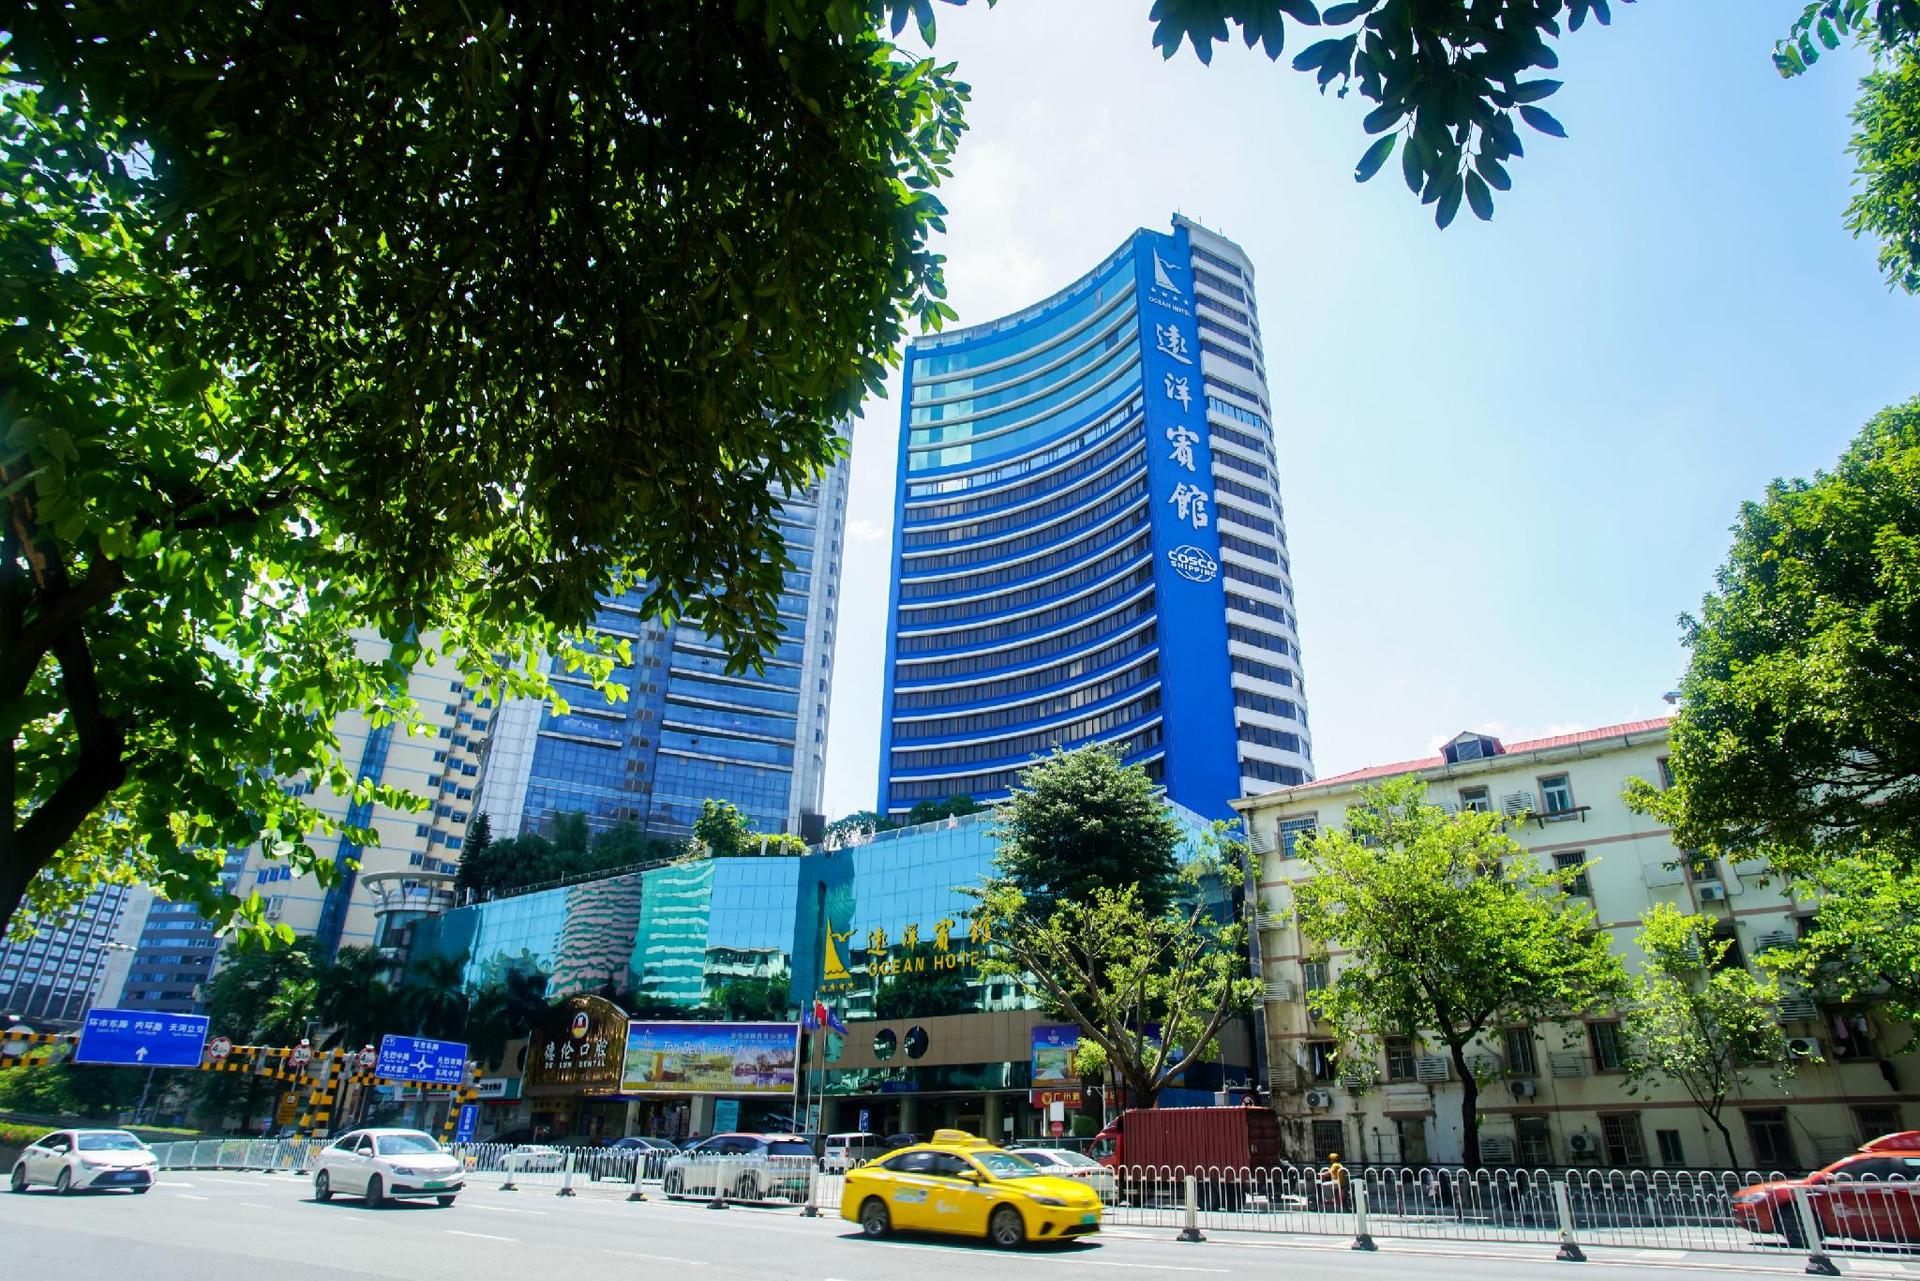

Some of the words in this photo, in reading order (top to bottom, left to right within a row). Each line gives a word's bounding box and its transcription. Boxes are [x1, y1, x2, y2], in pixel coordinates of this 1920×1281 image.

[1149, 296, 1171, 310] OCEAN
[1172, 304, 1192, 317] HOTEL
[1168, 550, 1218, 572] COSCO
[1170, 561, 1217, 578] SHIPPING
[868, 956, 925, 977] OCEAN
[88, 1018, 128, 1029] 环市东路
[134, 1021, 163, 1031] 内环路
[169, 1023, 205, 1033] 天河立交
[544, 1039, 608, 1061] 德伦口腔
[578, 1060, 606, 1068] DENTAL
